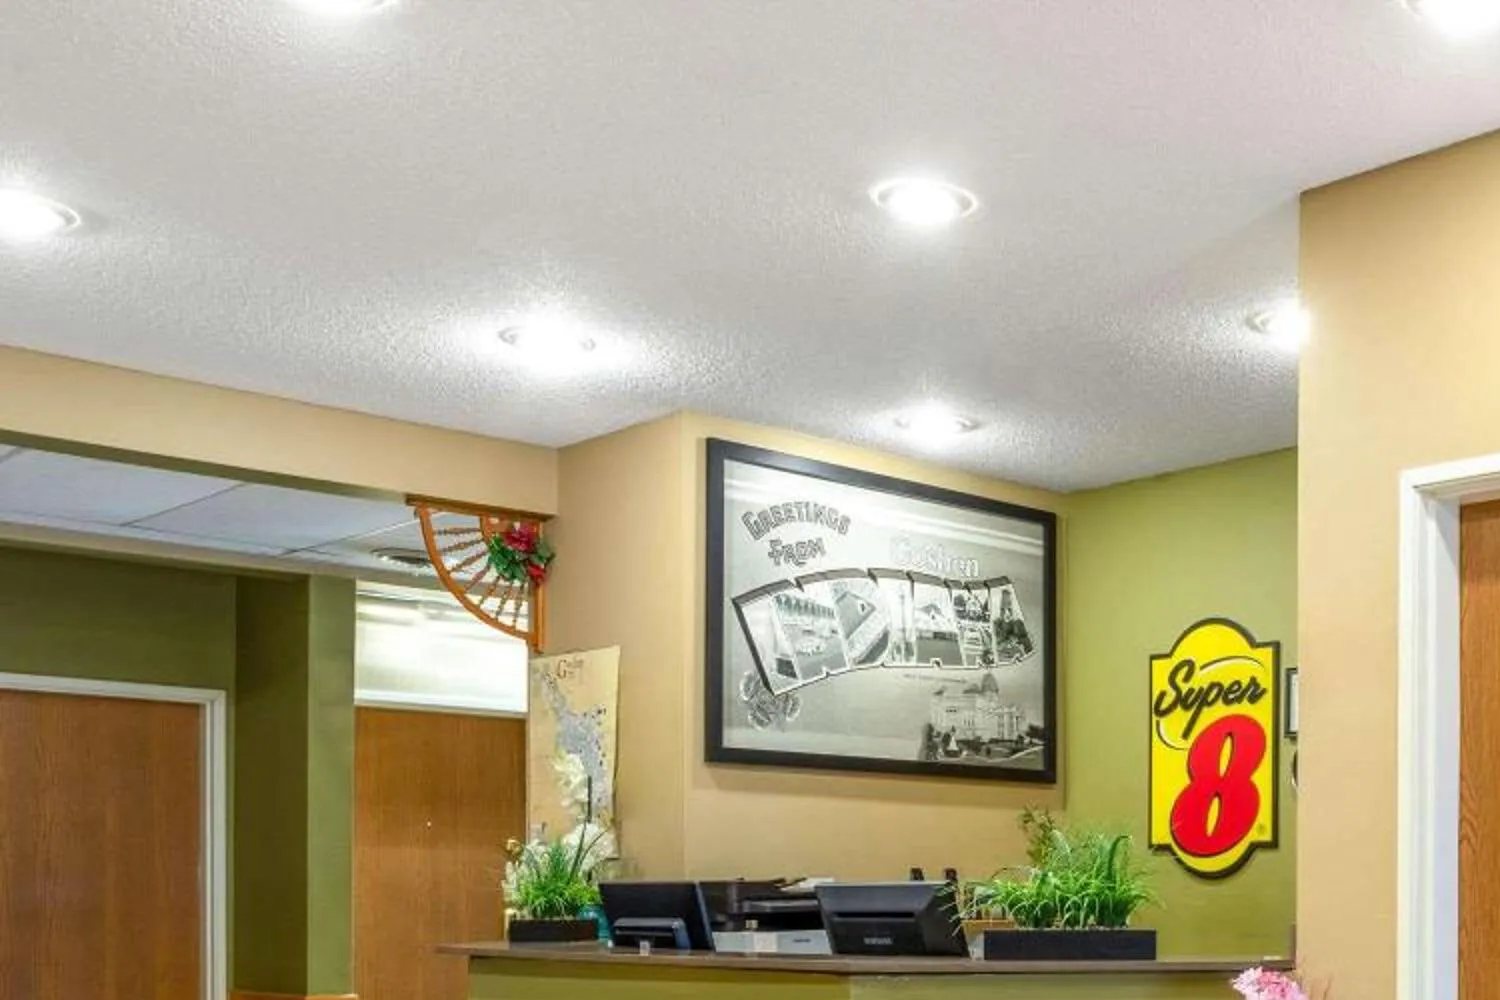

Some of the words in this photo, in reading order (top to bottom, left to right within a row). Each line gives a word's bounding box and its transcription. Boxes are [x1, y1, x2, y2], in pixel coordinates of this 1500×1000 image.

[741, 501, 851, 540] GREETINGS
[768, 538, 826, 566] FROM
[1154, 658, 1267, 740] Super
[1169, 713, 1267, 858] 8
